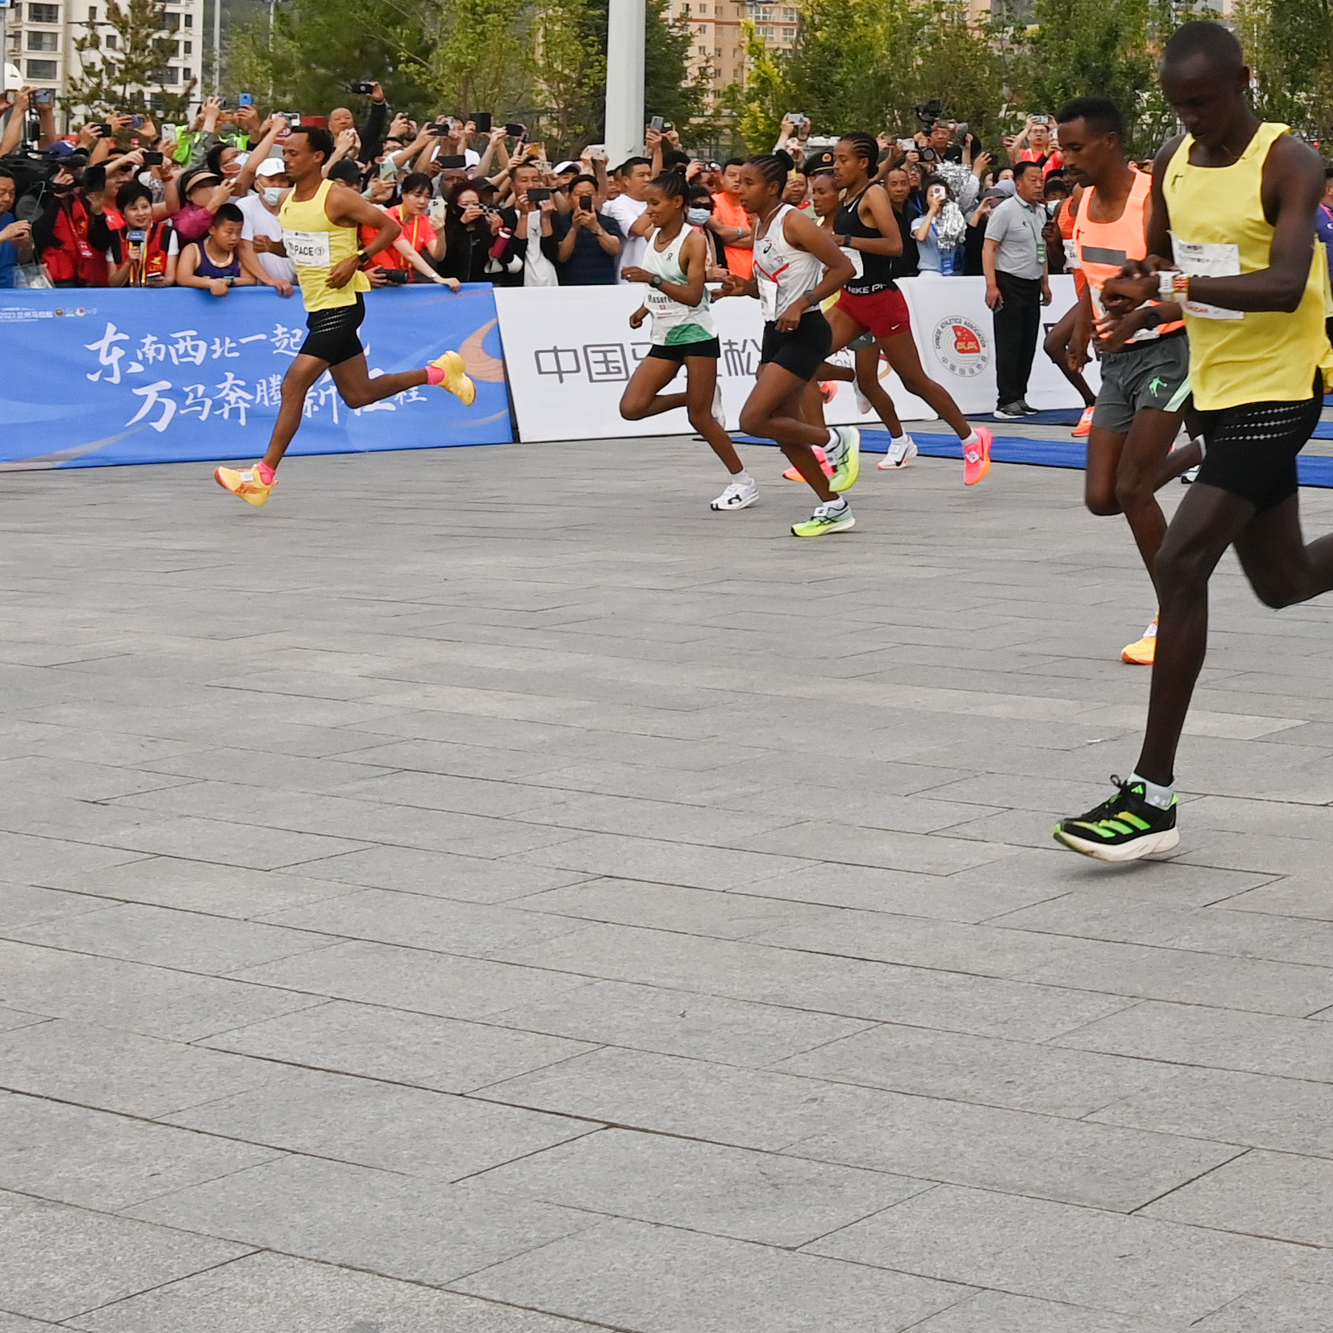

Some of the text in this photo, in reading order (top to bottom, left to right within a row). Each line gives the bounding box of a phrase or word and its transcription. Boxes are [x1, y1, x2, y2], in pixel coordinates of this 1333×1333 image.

[84, 322, 370, 385] 东南西北一起
